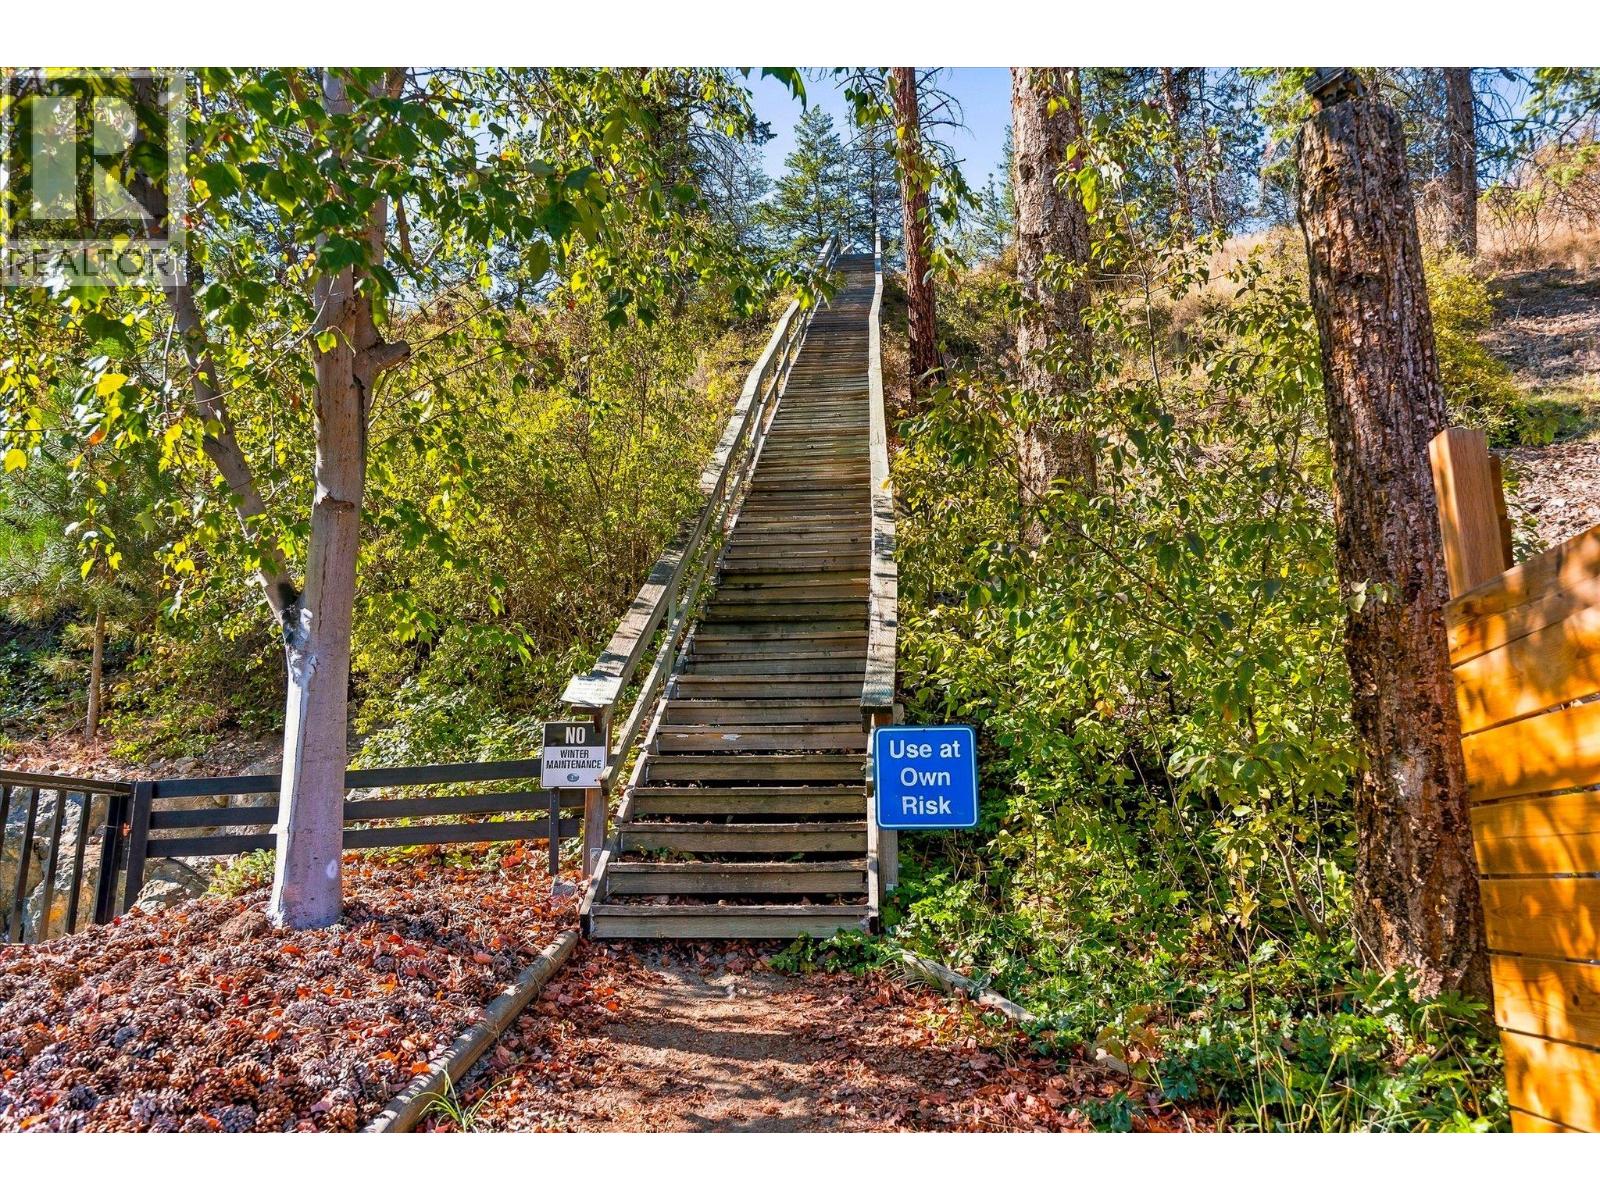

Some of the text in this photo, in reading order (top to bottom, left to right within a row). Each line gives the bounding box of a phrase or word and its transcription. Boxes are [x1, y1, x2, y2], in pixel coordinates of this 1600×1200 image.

[565, 726, 586, 744] NO
[560, 749, 589, 759] WINTER
[889, 740, 961, 758] Use at
[546, 759, 602, 769] MAINTENANCE
[900, 767, 951, 787] Own
[902, 796, 952, 815] Risk
